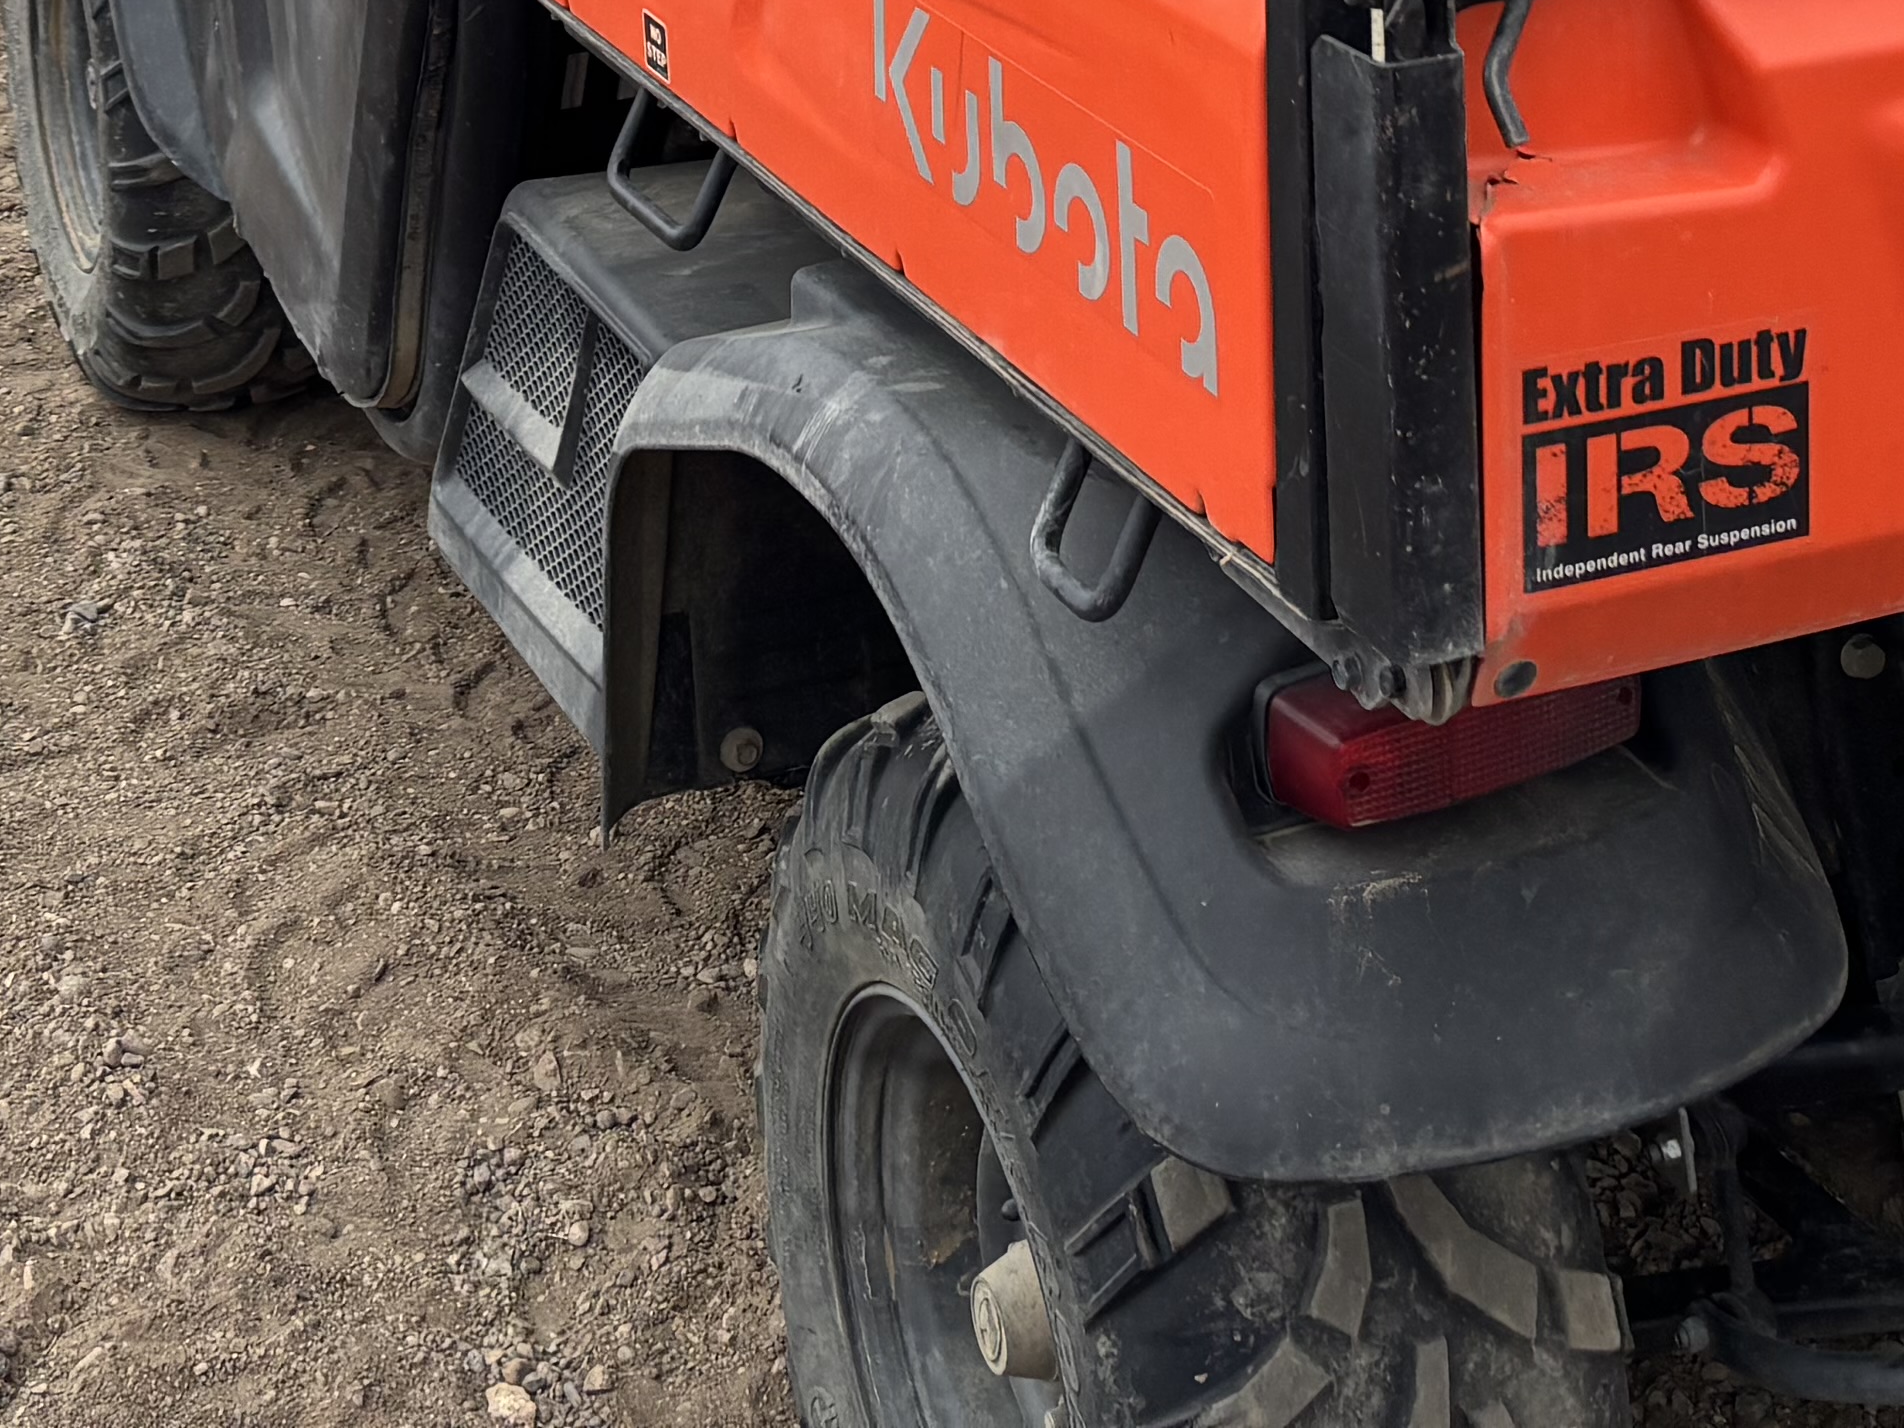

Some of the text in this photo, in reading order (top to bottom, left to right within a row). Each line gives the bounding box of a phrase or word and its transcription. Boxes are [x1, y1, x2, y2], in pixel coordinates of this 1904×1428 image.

[646, 41, 667, 68] STEP
[649, 23, 663, 46] NO
[1522, 327, 1807, 425] Extra Duty
[1535, 404, 1801, 548] IRS
[1535, 516, 1798, 583] Independent Rear Suspension
